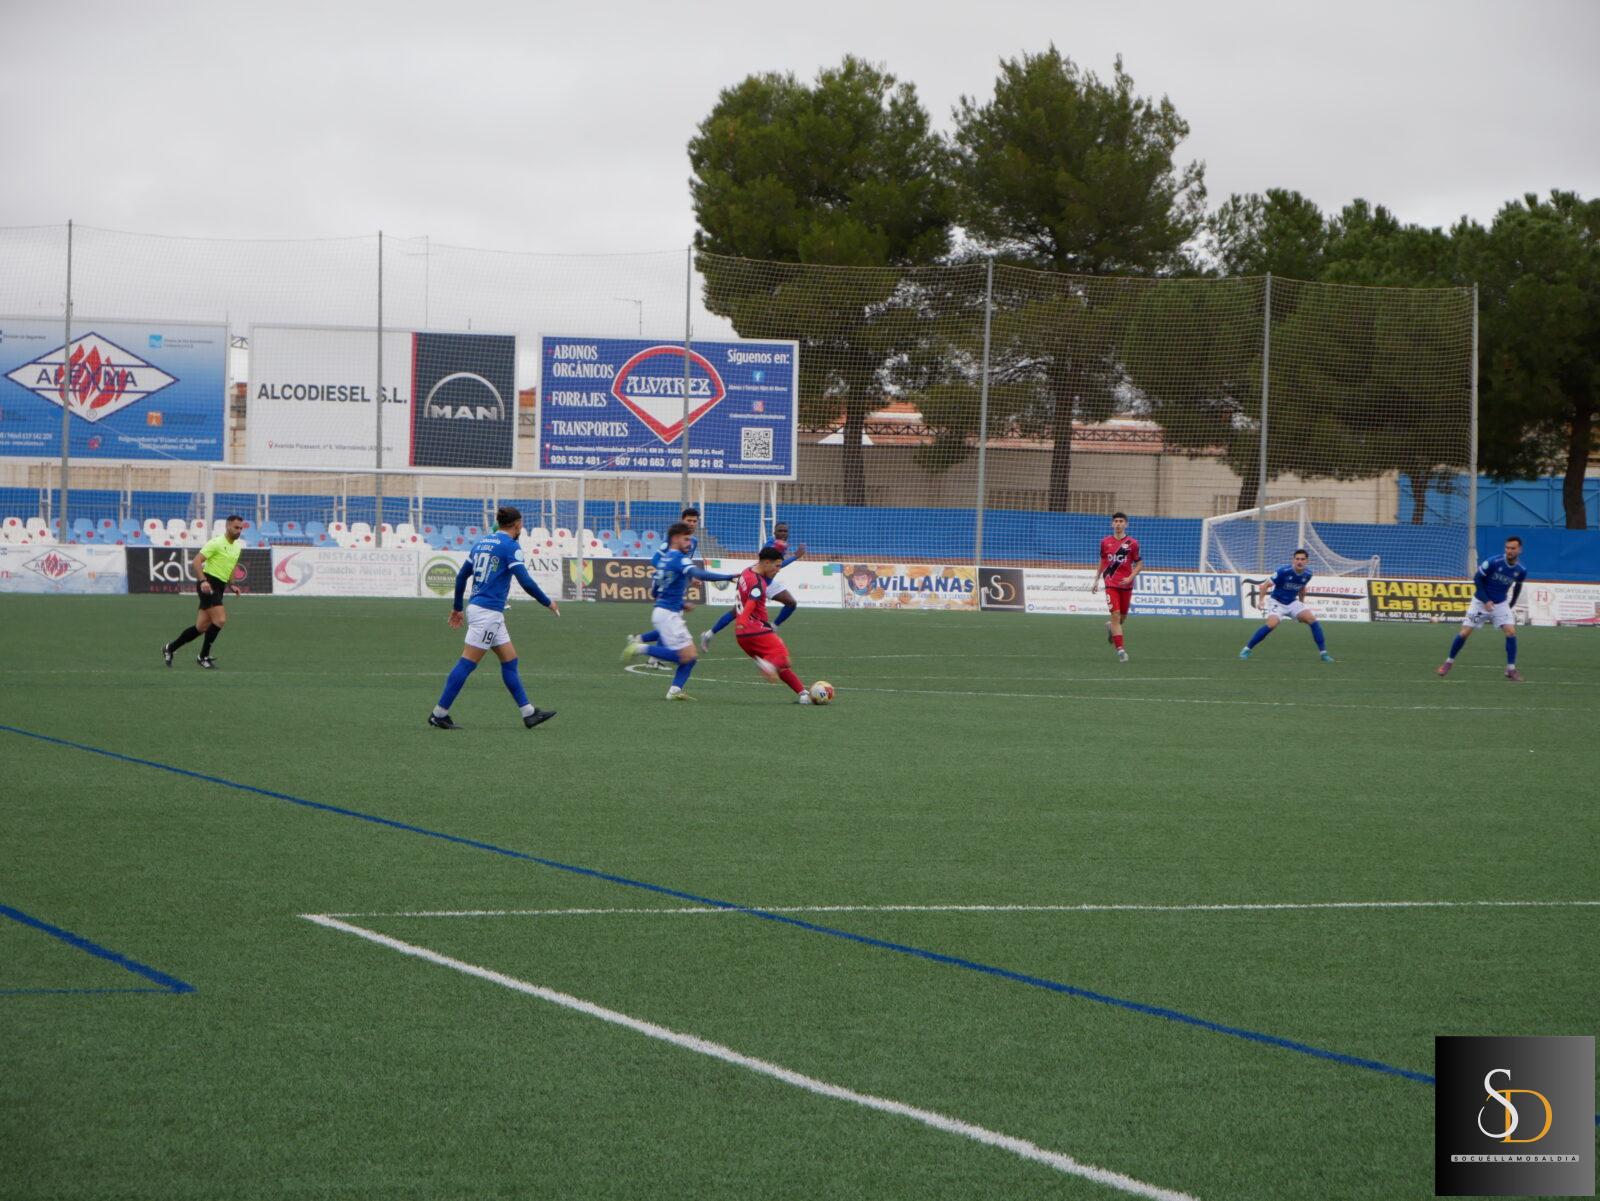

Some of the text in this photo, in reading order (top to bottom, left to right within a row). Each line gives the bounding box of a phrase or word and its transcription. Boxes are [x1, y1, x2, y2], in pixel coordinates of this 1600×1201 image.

[553, 345, 598, 360] ABONOS
[727, 349, 790, 365] Síguenos en:
[553, 360, 614, 379] ORGÁNICOS
[257, 383, 371, 403] ALCODIESEL
[552, 391, 607, 407] FORRAJES
[431, 405, 498, 420] MAN
[552, 420, 628, 437] TRANSPORTES
[318, 551, 412, 562] INSTALACIONES
[527, 557, 559, 572] ANS
[1133, 575, 1237, 595] LERES BAMCABI
[1134, 596, 1165, 604] CHAPA
[1177, 598, 1219, 606] PINTURA
[1377, 596, 1414, 610] Las
[482, 630, 494, 644] 19
